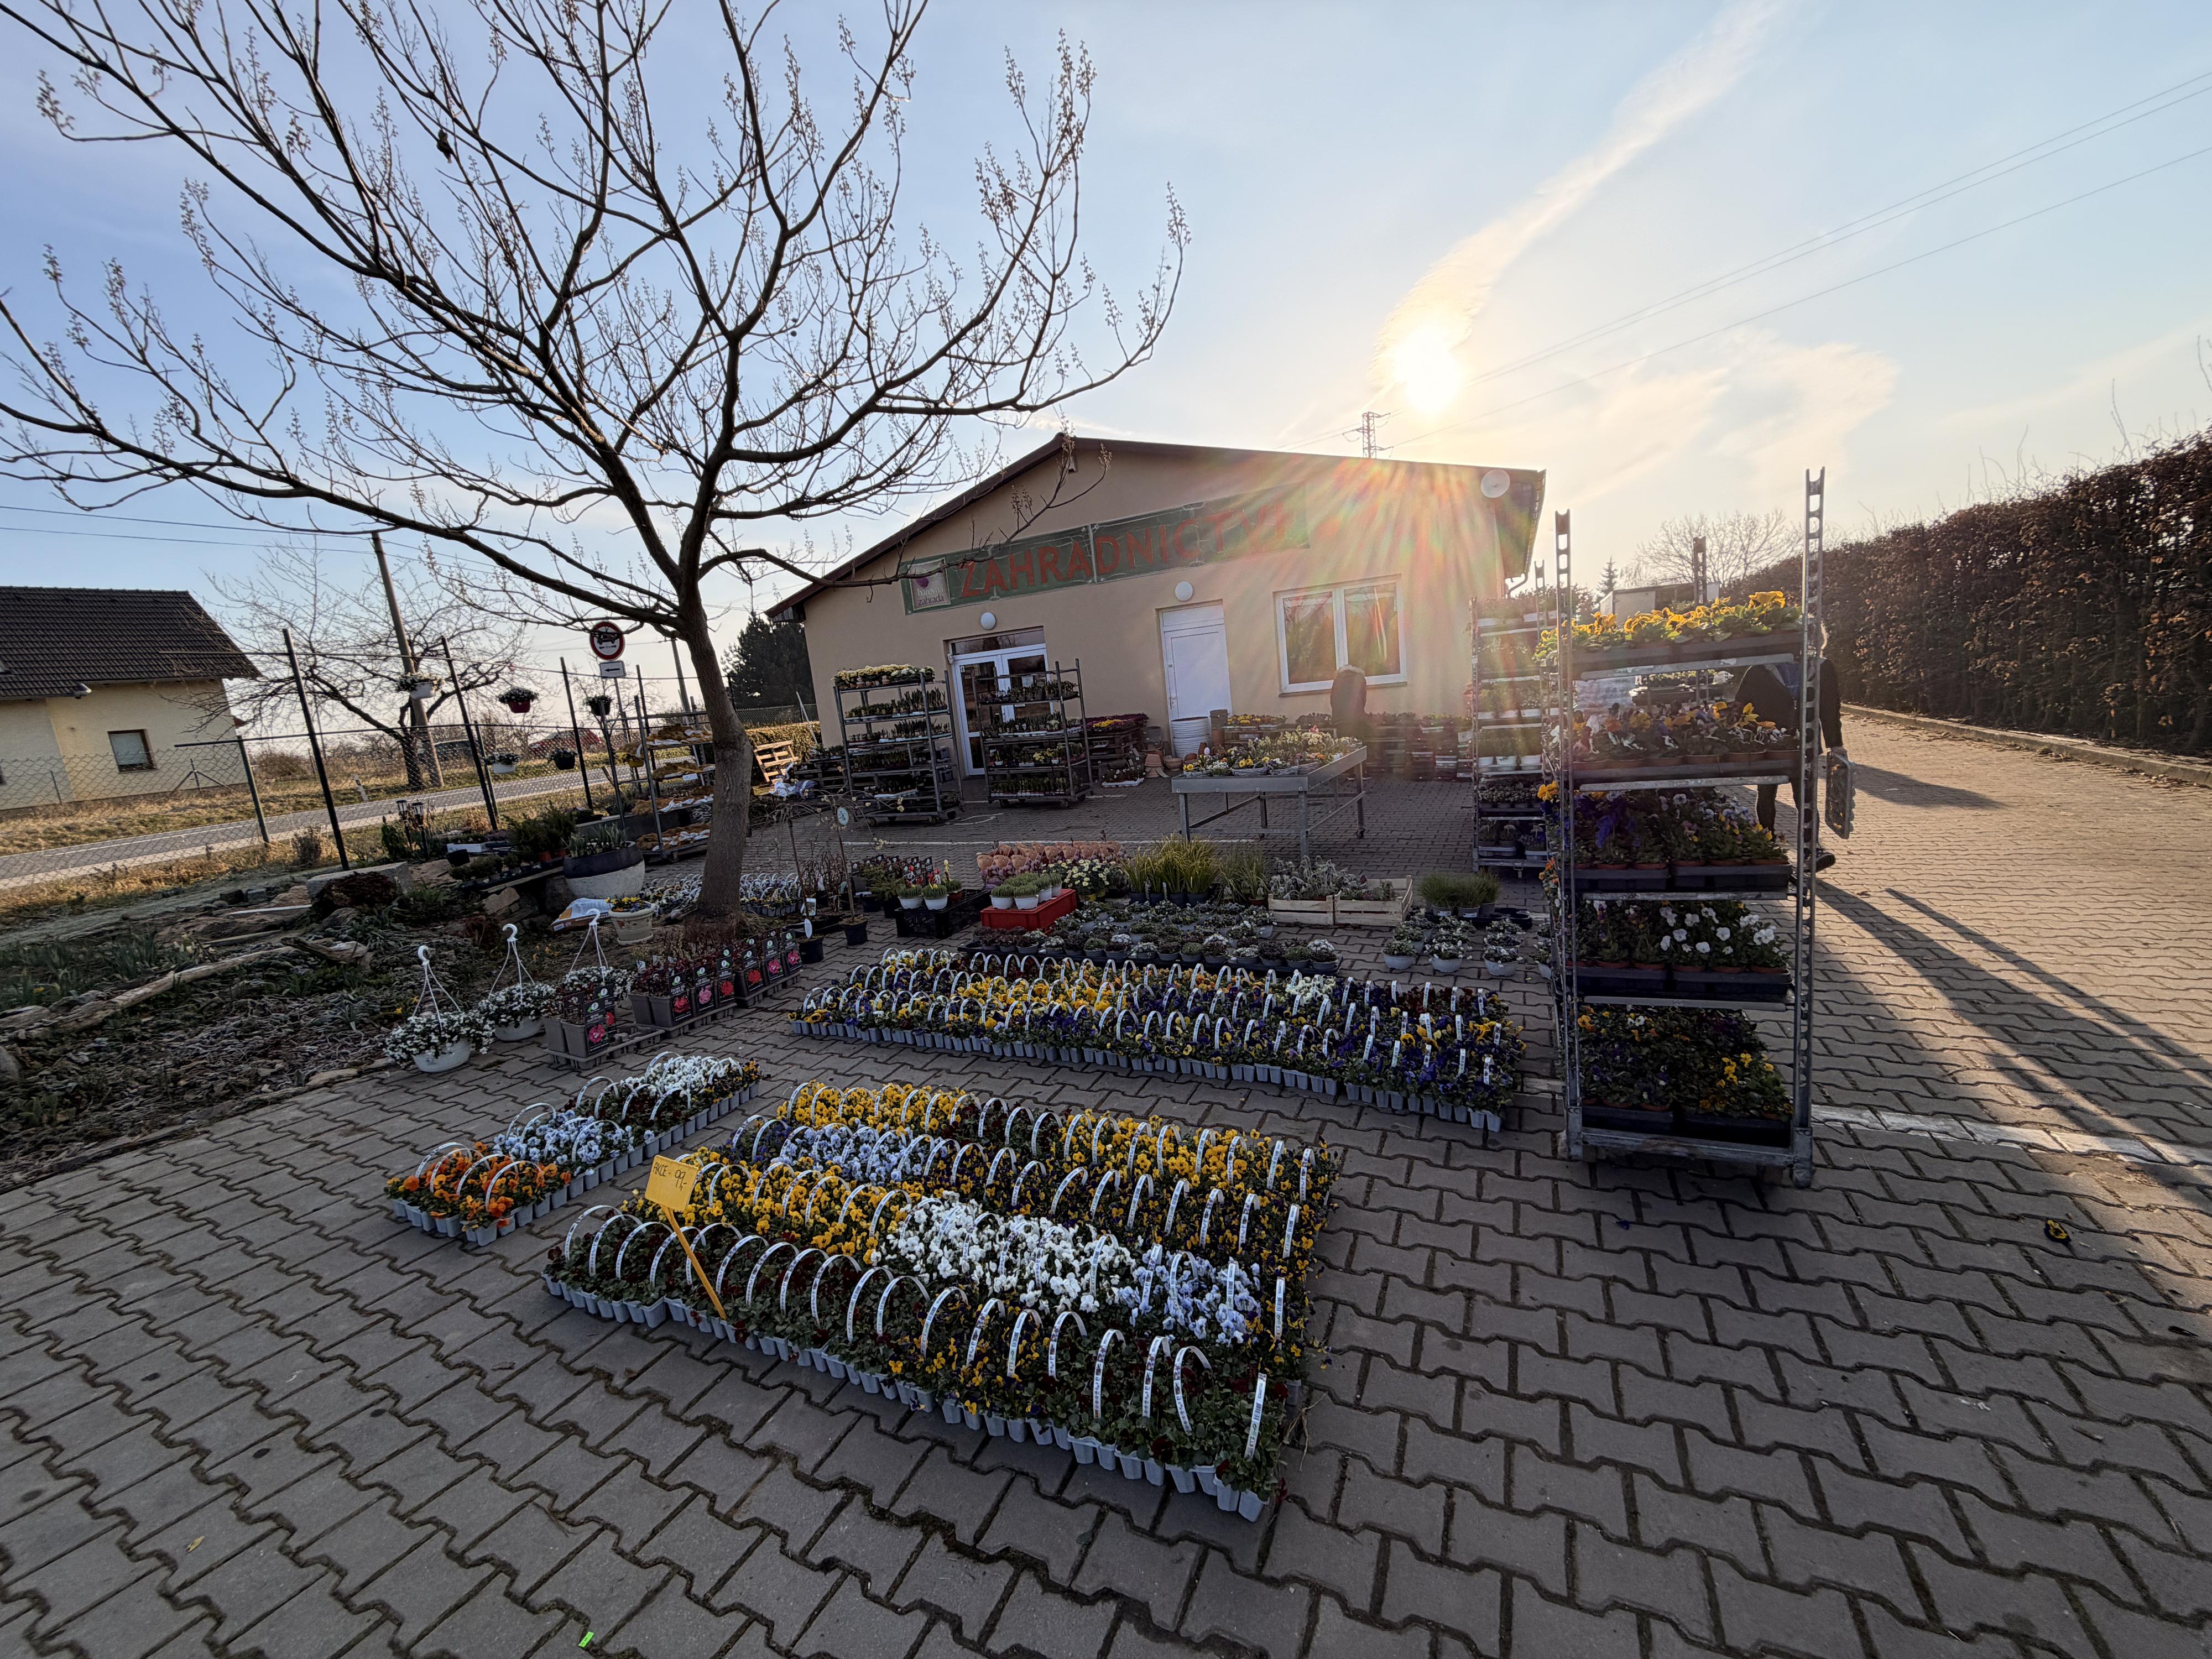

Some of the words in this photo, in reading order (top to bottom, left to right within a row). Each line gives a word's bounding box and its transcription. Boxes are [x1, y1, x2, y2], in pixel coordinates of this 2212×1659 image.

[959, 492, 1284, 598] ZAHRADNICTVÍ
[919, 593, 945, 606] zahrada
[653, 1162, 668, 1177] AKCE
